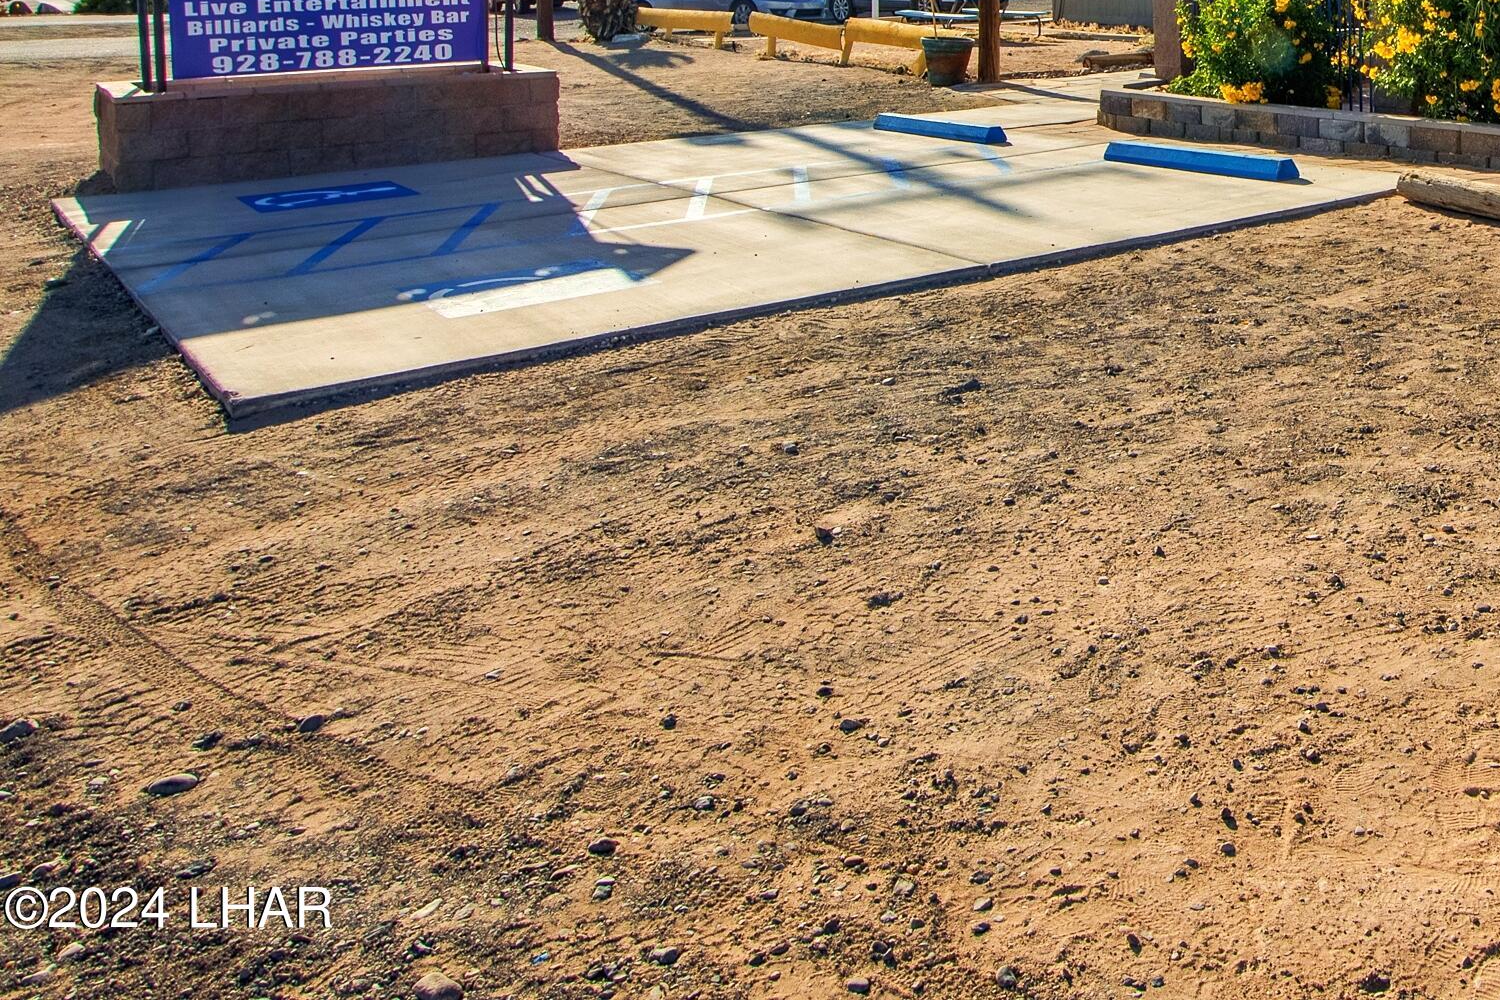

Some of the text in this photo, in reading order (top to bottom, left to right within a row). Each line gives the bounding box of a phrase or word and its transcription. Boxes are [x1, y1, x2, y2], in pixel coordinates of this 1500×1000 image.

[184, 1, 247, 17] Live
[187, 17, 300, 36] Billiards
[321, 12, 424, 29] Whiskey
[431, 10, 469, 24] Bar
[209, 28, 454, 53] Private Parties
[212, 43, 453, 74] 928-788-2240
